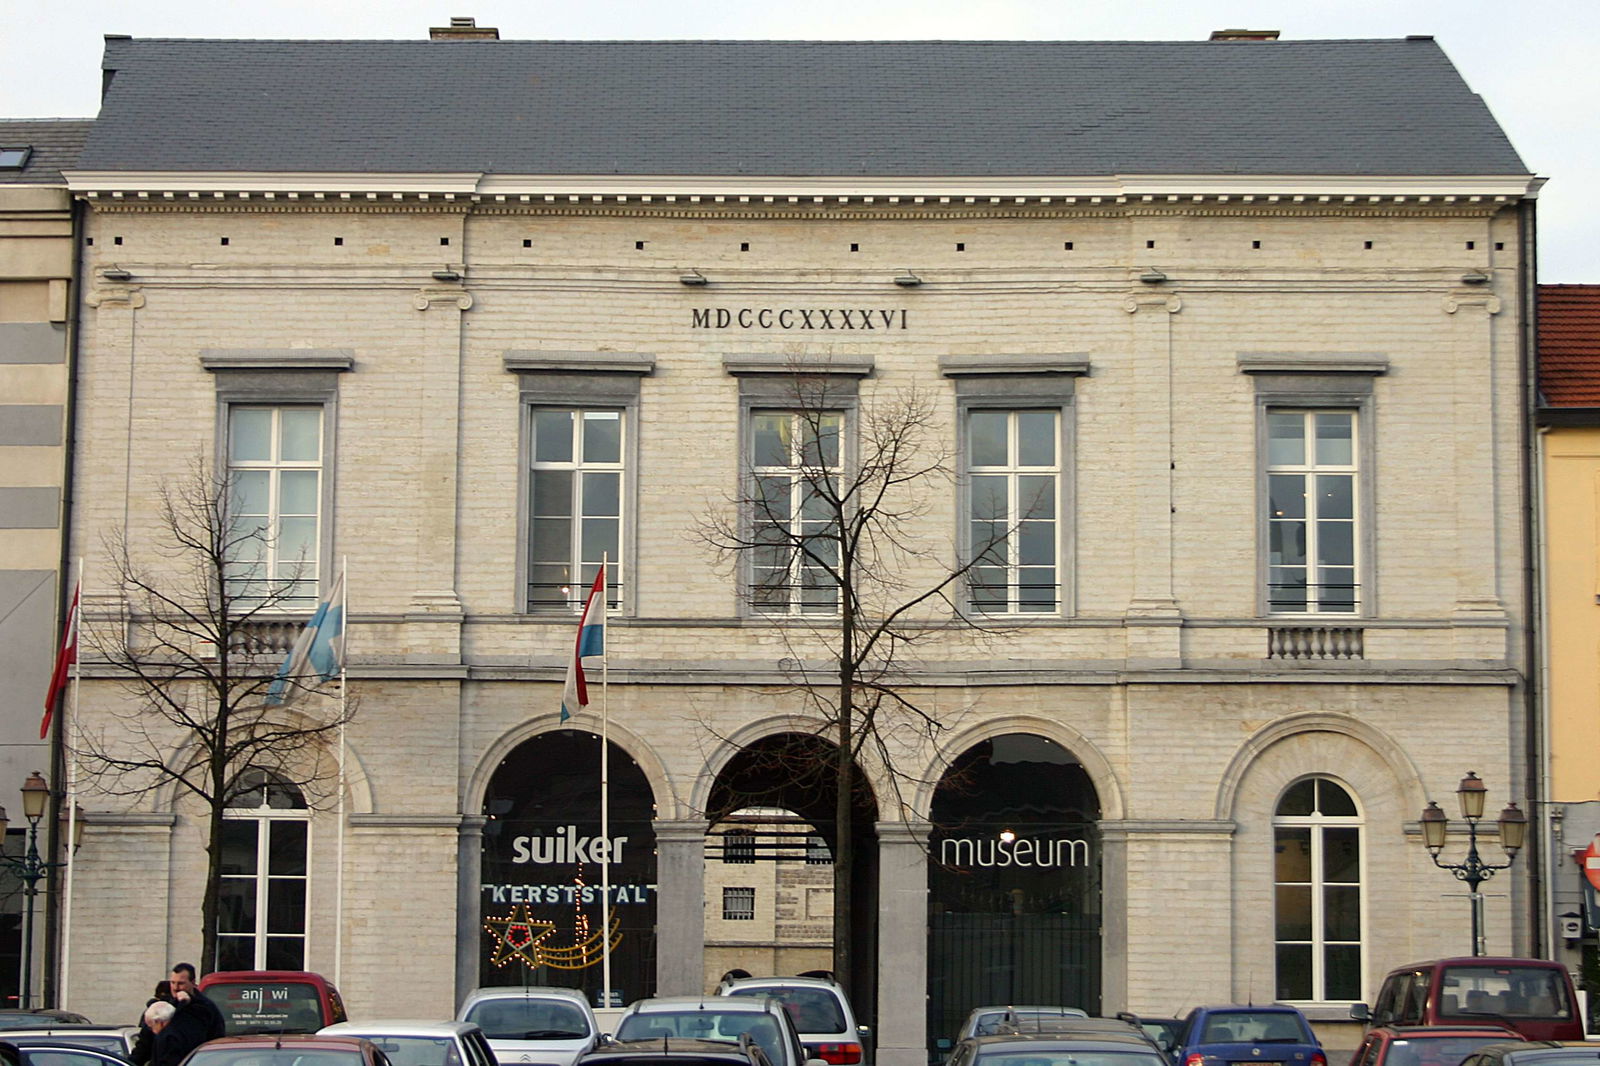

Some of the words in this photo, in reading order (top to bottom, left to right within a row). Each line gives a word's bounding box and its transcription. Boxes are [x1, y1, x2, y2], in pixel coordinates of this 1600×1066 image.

[692, 308, 908, 330] MDCCCXXXXVI
[512, 825, 628, 864] suiker
[941, 837, 1089, 868] museum
